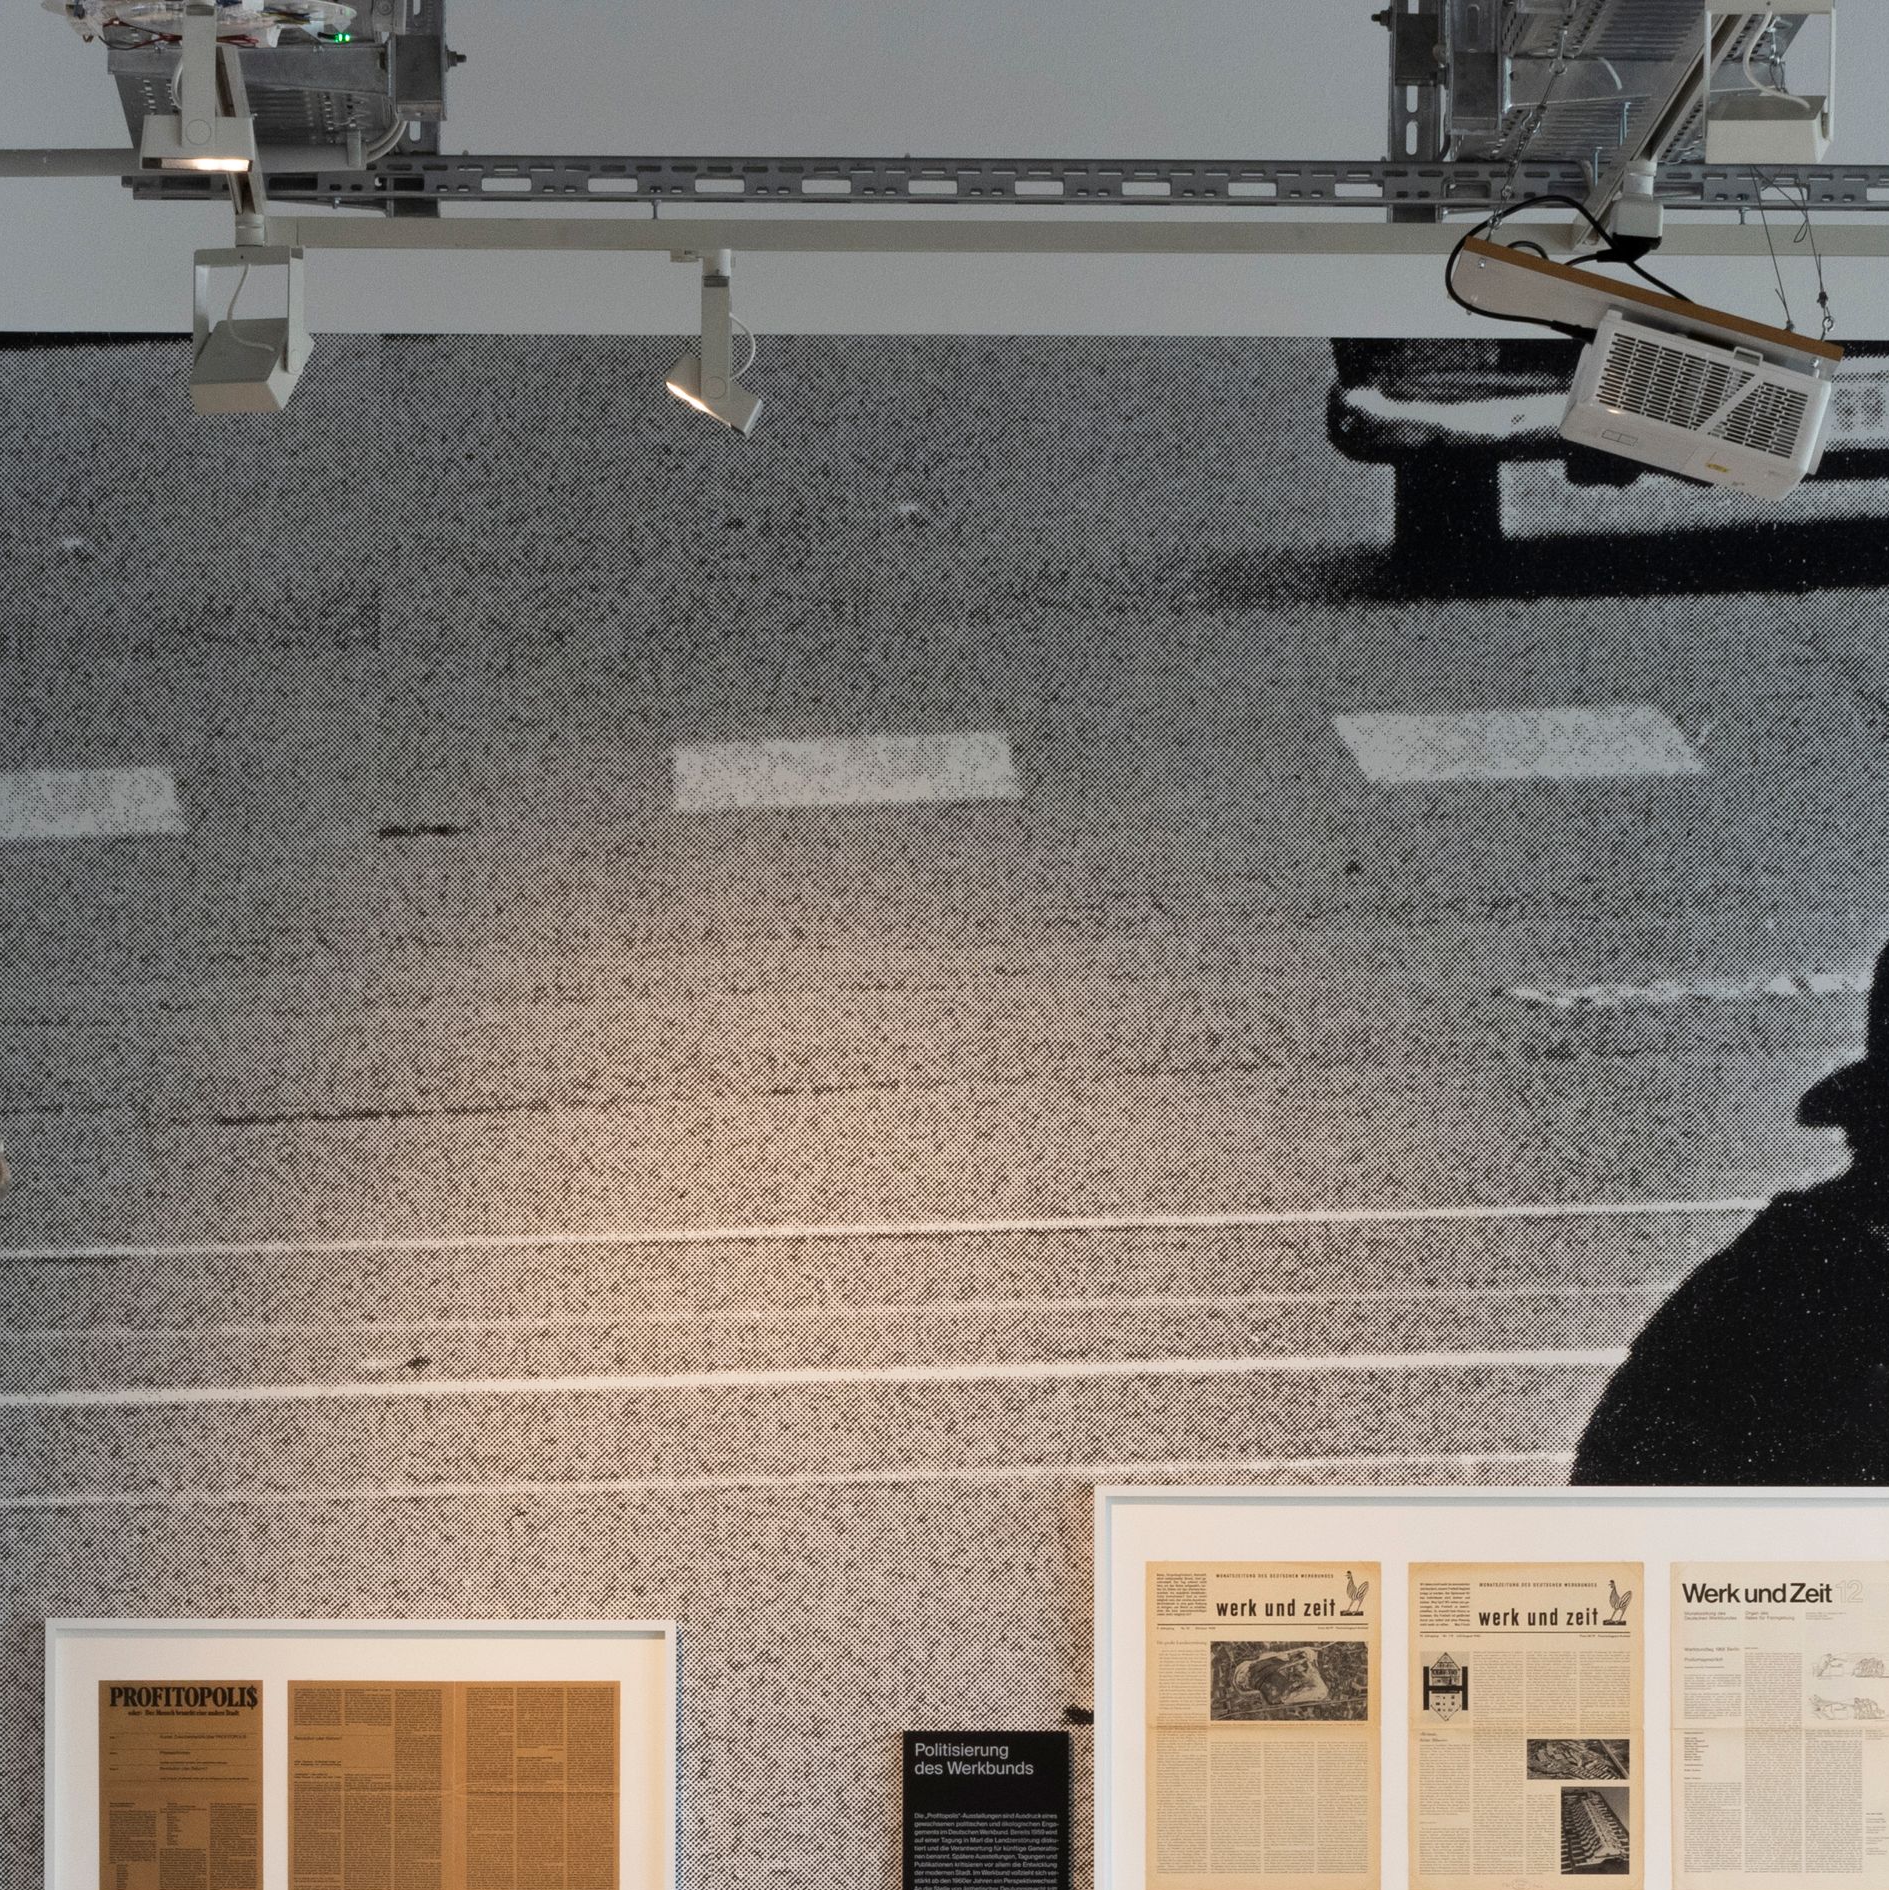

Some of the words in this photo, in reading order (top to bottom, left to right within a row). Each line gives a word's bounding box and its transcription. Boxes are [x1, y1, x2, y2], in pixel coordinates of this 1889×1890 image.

[1682, 1583, 1741, 1603] Werk
[1745, 1583, 1786, 1603] und
[1789, 1583, 1833, 1603] Zeit
[1836, 1579, 1864, 1604] 12
[1216, 1599, 1257, 1617] werk
[1265, 1599, 1296, 1617] und
[1303, 1599, 1336, 1617] zeit
[1478, 1608, 1519, 1626] werk
[1527, 1608, 1558, 1626] und
[1566, 1608, 1598, 1626] zeit
[915, 1742, 1009, 1760] Politisierung
[914, 1761, 943, 1775] des
[947, 1761, 1034, 1775] Werkbunds
